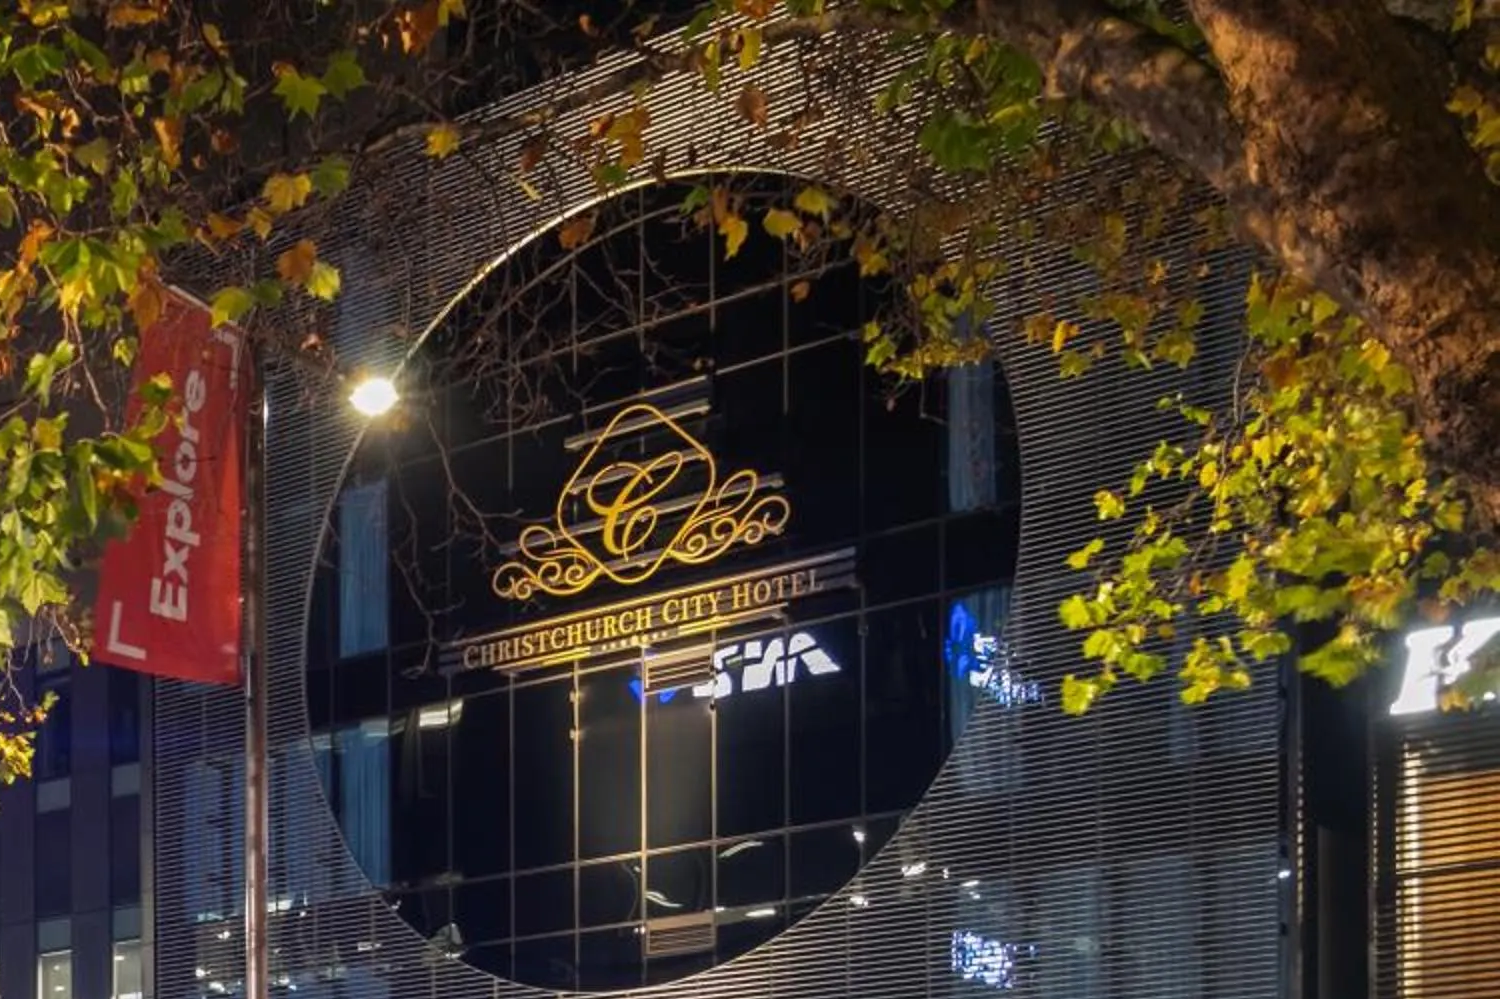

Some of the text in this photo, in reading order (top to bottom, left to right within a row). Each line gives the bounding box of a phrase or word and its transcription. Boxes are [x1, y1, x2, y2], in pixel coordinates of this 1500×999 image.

[150, 369, 206, 622] Explore
[463, 568, 825, 670] CHRISTCHURCH CITY HOTEL
